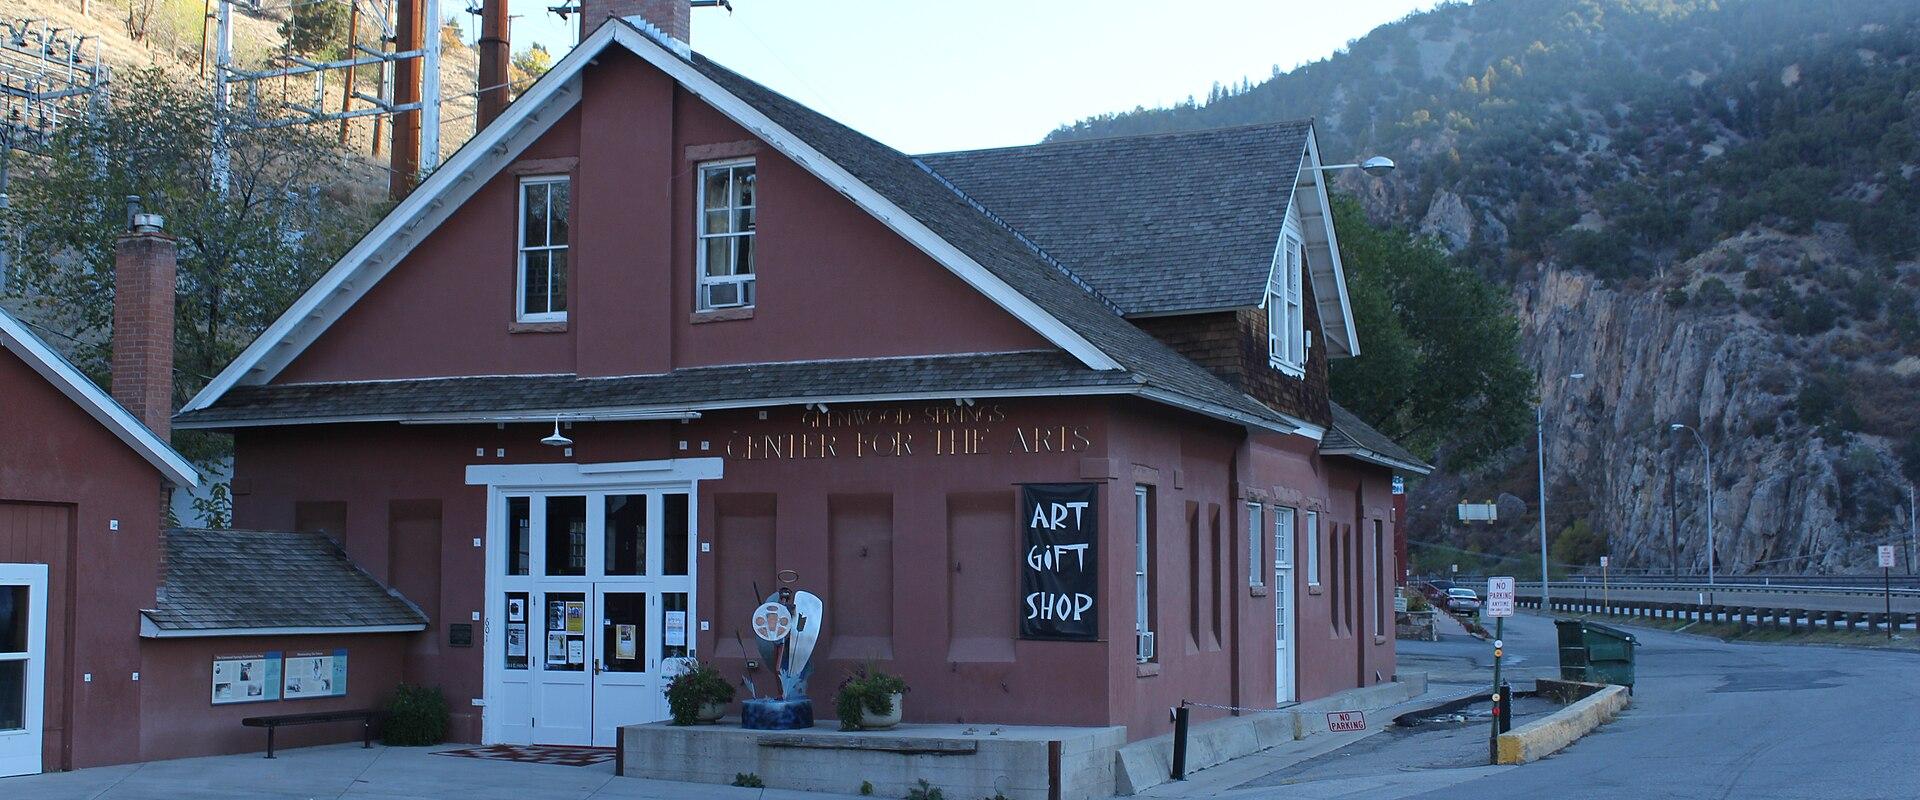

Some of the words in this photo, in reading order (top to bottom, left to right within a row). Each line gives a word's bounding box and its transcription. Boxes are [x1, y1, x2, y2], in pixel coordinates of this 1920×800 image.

[802, 408, 911, 427] GLENWOOD
[924, 405, 1007, 423] SPRINGS
[727, 432, 837, 459] CENTER
[857, 431, 912, 457] FOR
[929, 427, 990, 454] THE
[1009, 425, 1090, 453] ARTS
[1031, 502, 1089, 531] ART
[1495, 582, 1506, 590] NO
[1489, 591, 1512, 600] PARKING
[1026, 592, 1093, 621] SHOP
[1331, 720, 1364, 730] PARKING
[1339, 713, 1350, 721] NO
